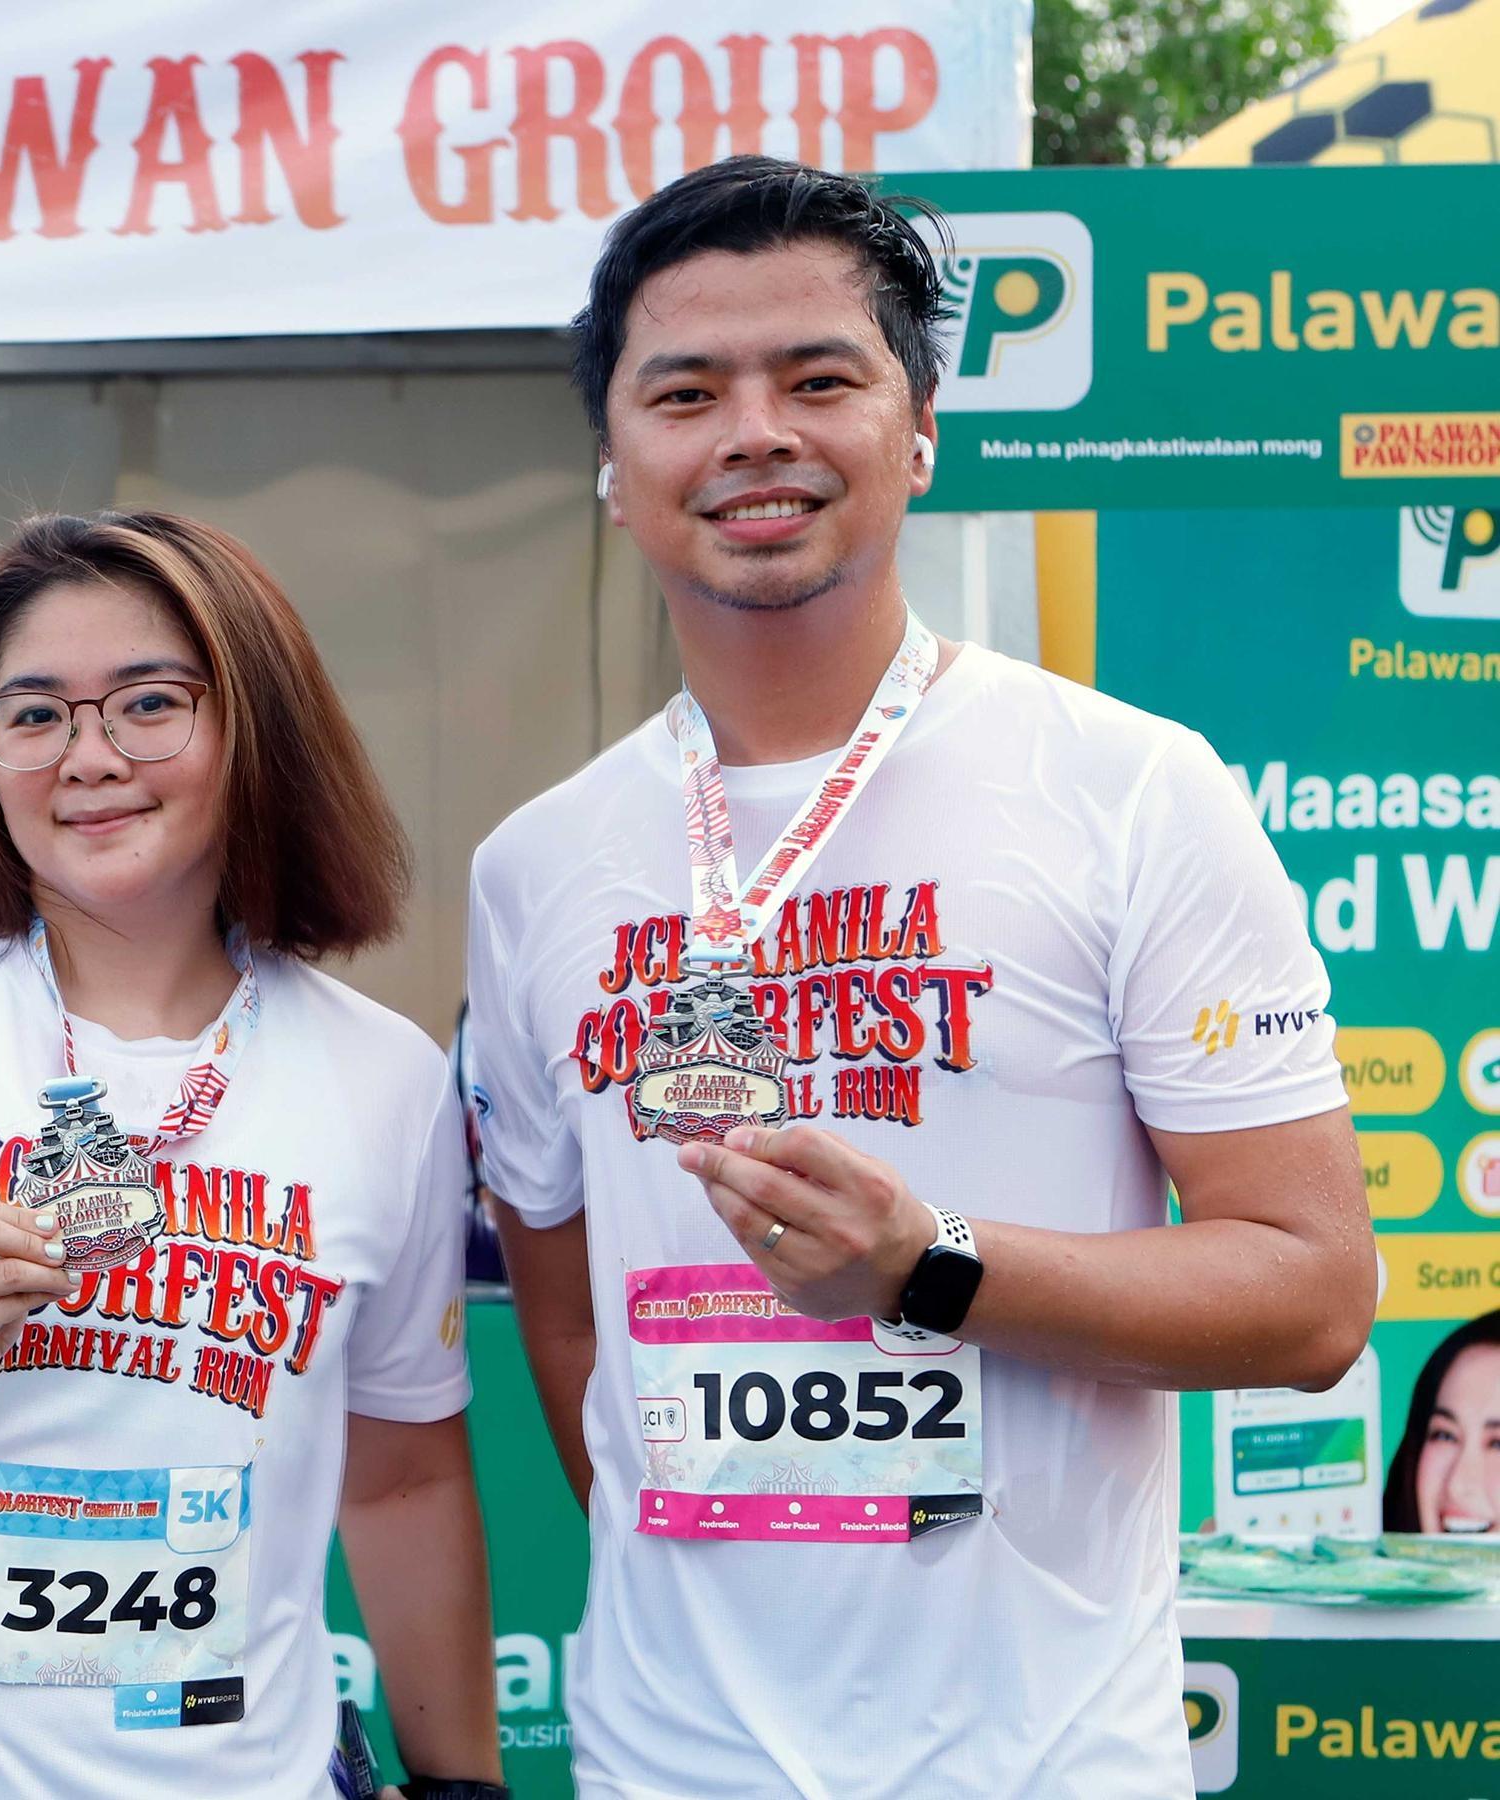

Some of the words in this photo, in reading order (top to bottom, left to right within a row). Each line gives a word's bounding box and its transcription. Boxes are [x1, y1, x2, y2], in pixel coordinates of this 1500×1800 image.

[981, 439, 1032, 459] Mula
[1037, 442, 1062, 458] sa
[1065, 437, 1259, 462] pinagkakatiwalaan
[1263, 440, 1323, 459] mong
[1354, 446, 1500, 467] PAWNSHOP
[599, 911, 691, 993] JCI
[673, 1074, 693, 1087] JCI
[695, 1075, 747, 1088] MANILA
[664, 1087, 756, 1105] COLORFEST
[677, 1101, 721, 1111] CARNIVAL
[723, 1103, 742, 1112] RUN
[832, 1064, 924, 1127] RUN
[55, 1200, 75, 1216] JCI
[76, 1191, 124, 1212] MANILA
[57, 1202, 133, 1230] OLORFEST
[63, 1222, 106, 1237] CARNIVAL
[106, 1218, 123, 1229] RUN
[1417, 1263, 1481, 1289] Scan
[188, 1346, 276, 1419] RUN
[694, 1370, 966, 1442] 10852
[178, 1487, 233, 1524] 3K
[699, 1519, 740, 1530] Hydration
[770, 1521, 792, 1531] Color
[840, 1522, 880, 1531] Finisher's
[881, 1522, 907, 1531] Medal
[1, 1566, 217, 1634] 3248
